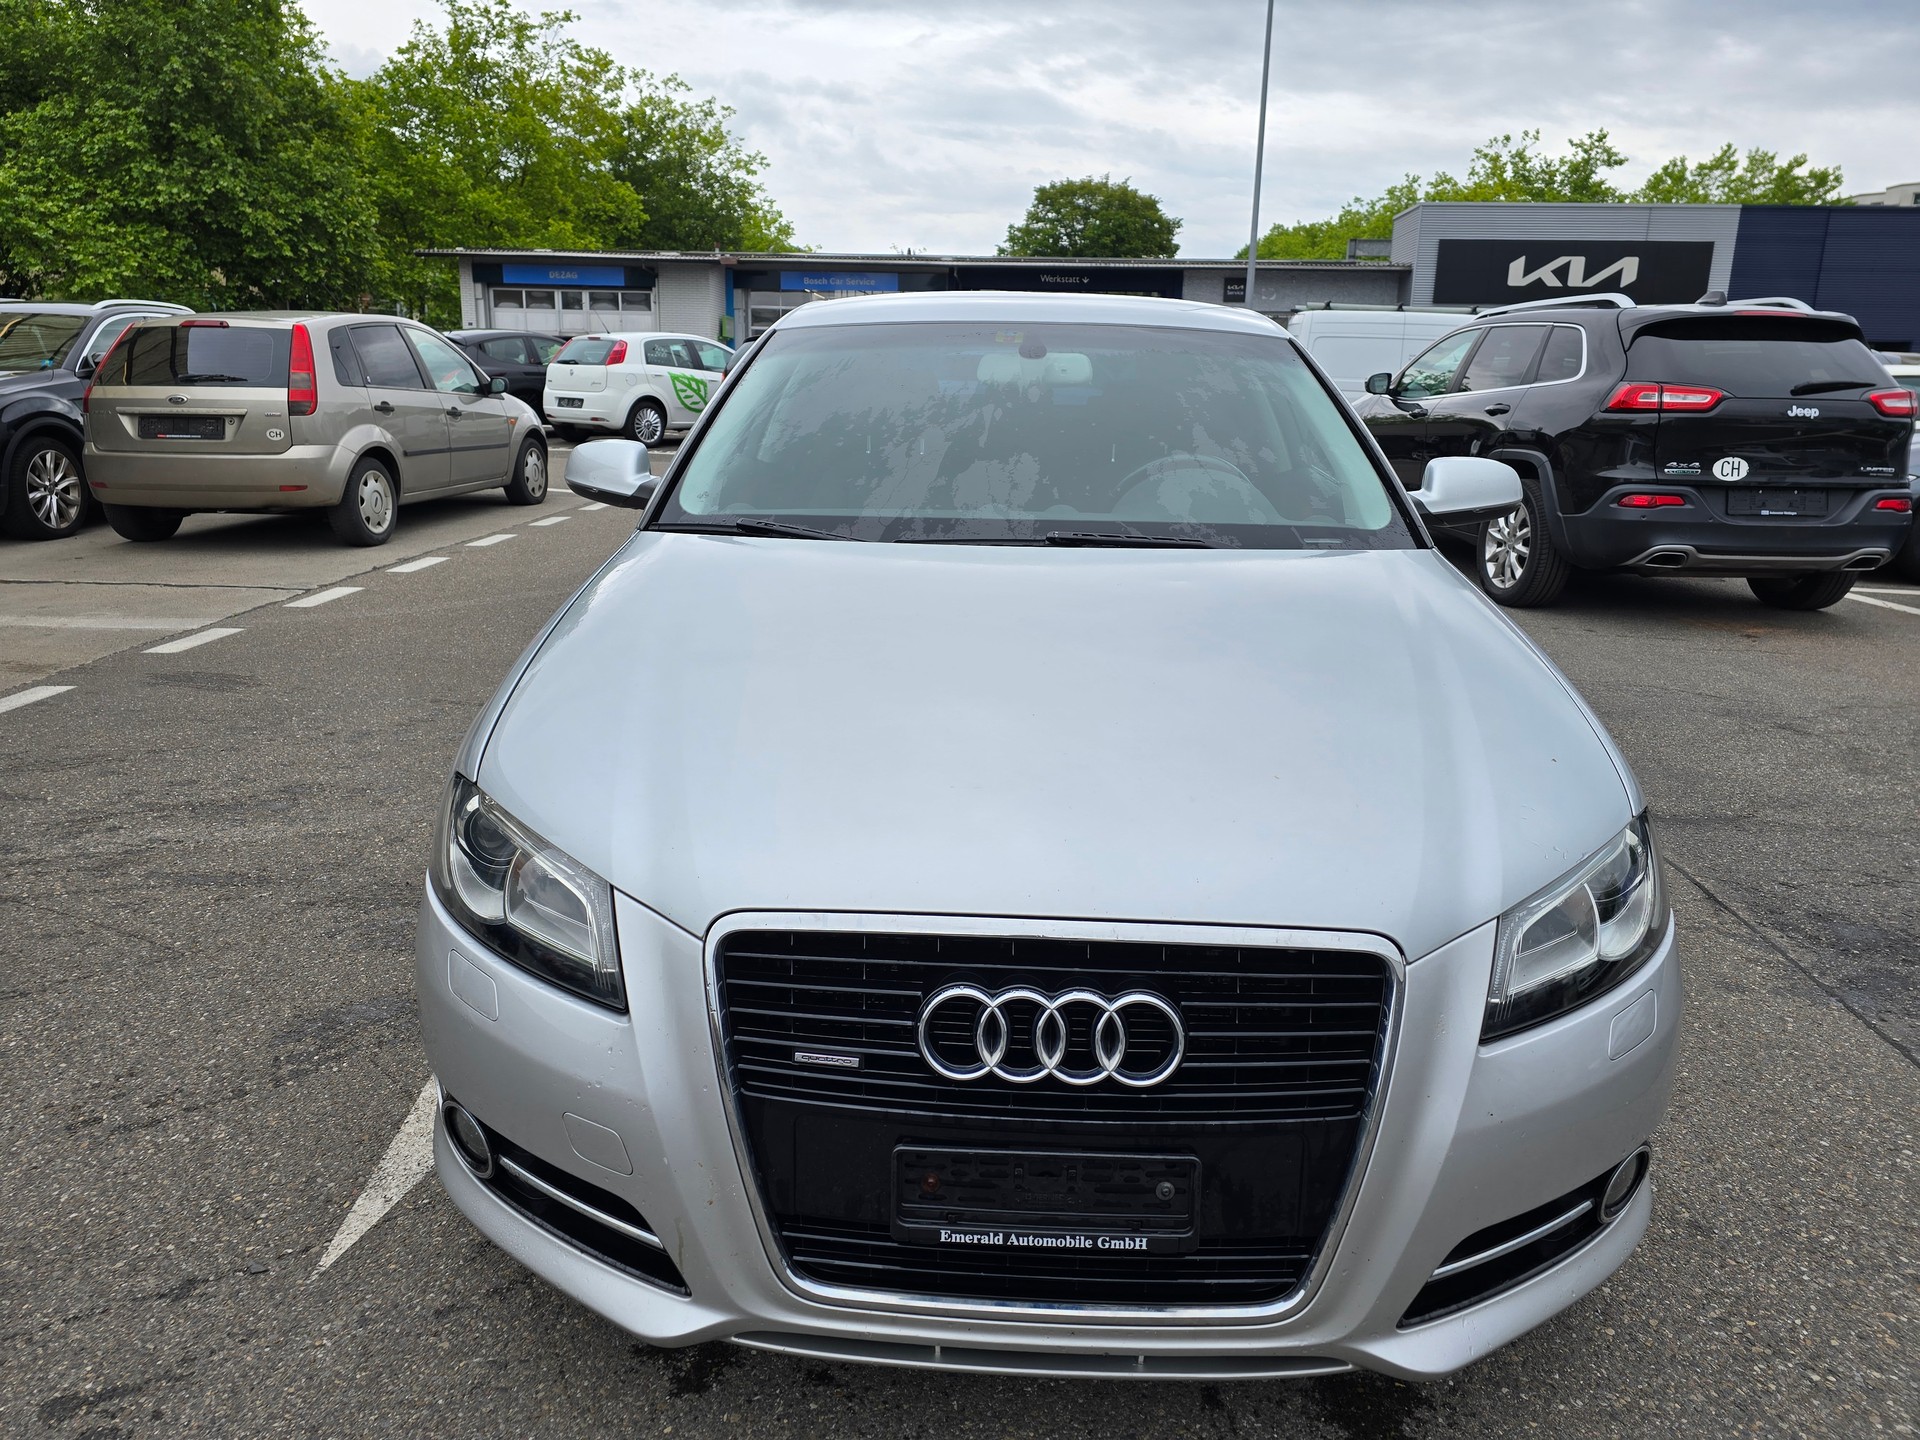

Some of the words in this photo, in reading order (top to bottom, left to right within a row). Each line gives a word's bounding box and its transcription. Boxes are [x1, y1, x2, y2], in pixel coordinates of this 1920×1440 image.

[1507, 255, 1640, 288] KIA
[803, 277, 828, 286] Bosch
[829, 278, 843, 286] Car
[846, 278, 876, 286] Service
[1040, 274, 1080, 283] Werkstatt
[1787, 405, 1820, 420] Jeep
[268, 430, 282, 438] CH
[1720, 460, 1741, 477] CH
[801, 1054, 852, 1065] quattro
[939, 1229, 1004, 1245] Emerald
[1006, 1232, 1093, 1249] Automobile
[1097, 1235, 1148, 1251] GmbH
